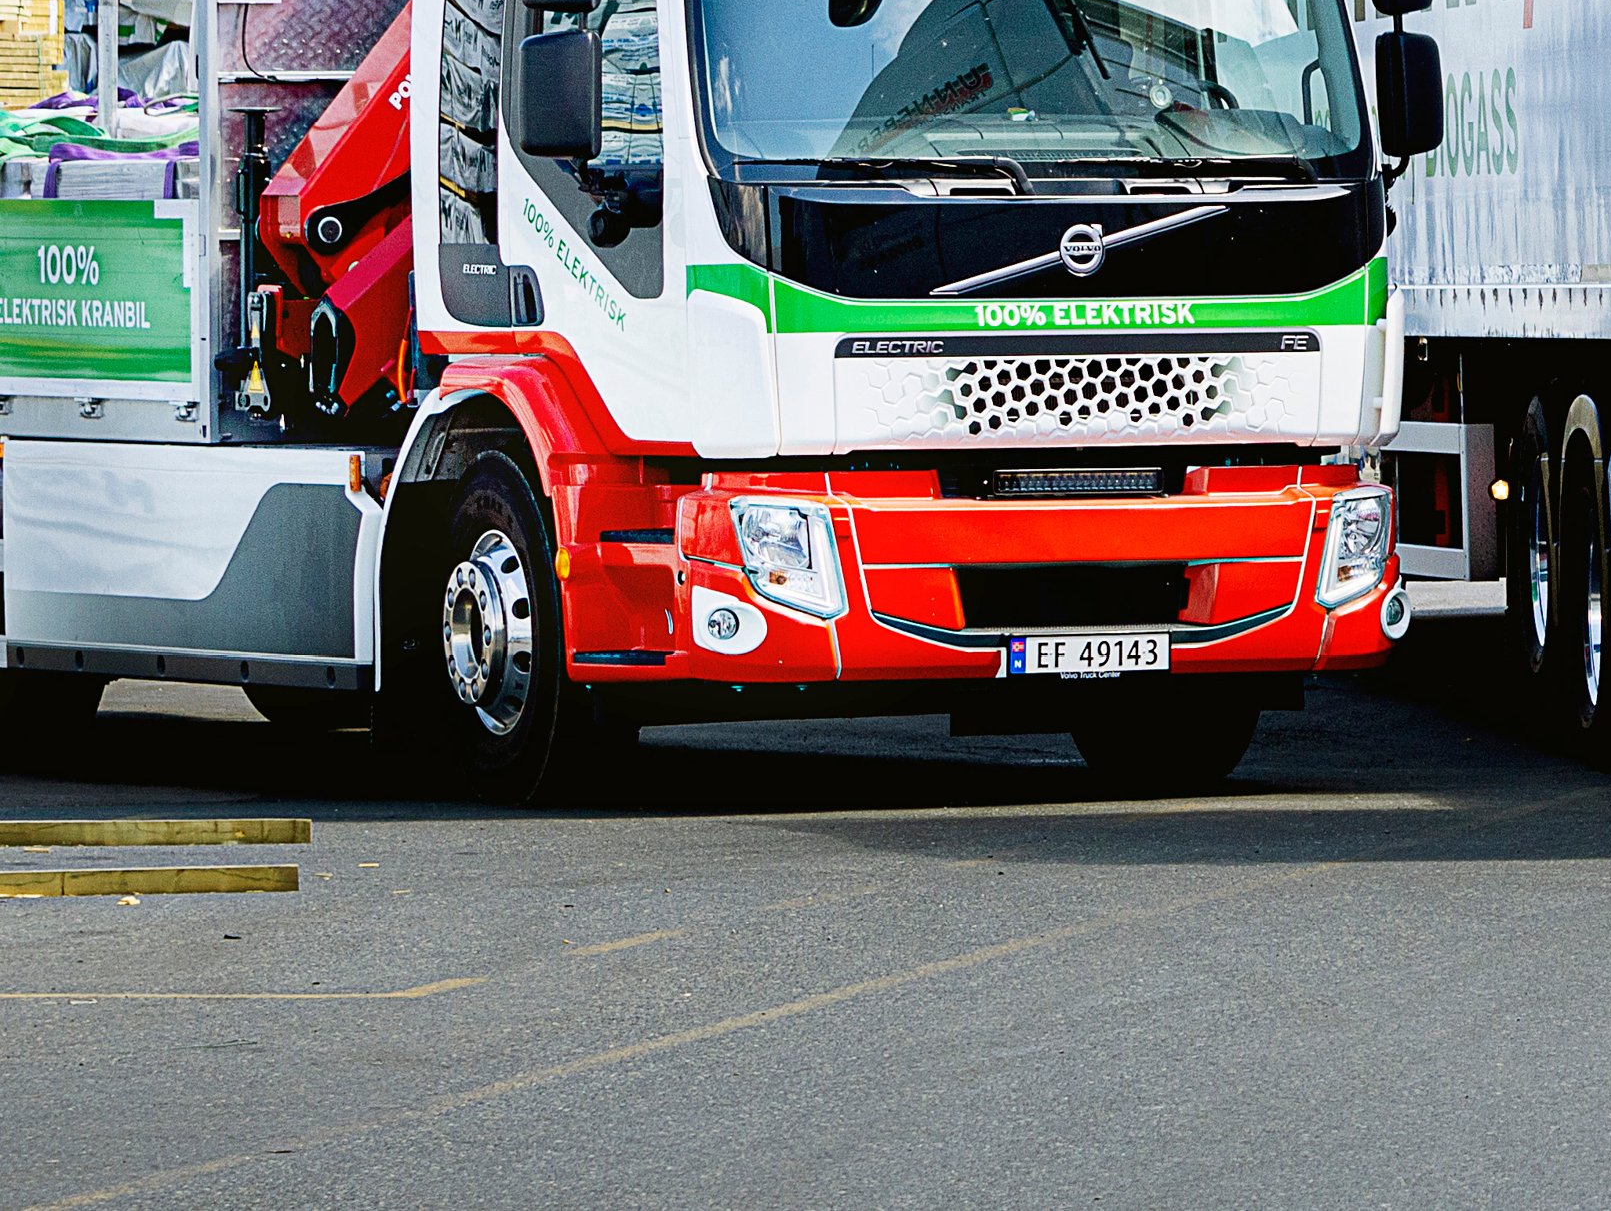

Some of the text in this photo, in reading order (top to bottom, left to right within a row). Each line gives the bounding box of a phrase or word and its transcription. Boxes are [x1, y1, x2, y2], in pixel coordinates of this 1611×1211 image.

[37, 244, 100, 286] 100%
[462, 263, 498, 275] ELECTRIC
[523, 198, 627, 332] 100% ELEKTRISK
[81, 299, 151, 329] KRANBIL
[975, 303, 1196, 327] 100% ELEKTRISK
[851, 341, 945, 354] ELECTRIC
[1280, 335, 1309, 350] FE
[1037, 639, 1158, 668] EF 49143
[1014, 659, 1022, 669] N
[1060, 670, 1121, 679] Volvo Truck Center
